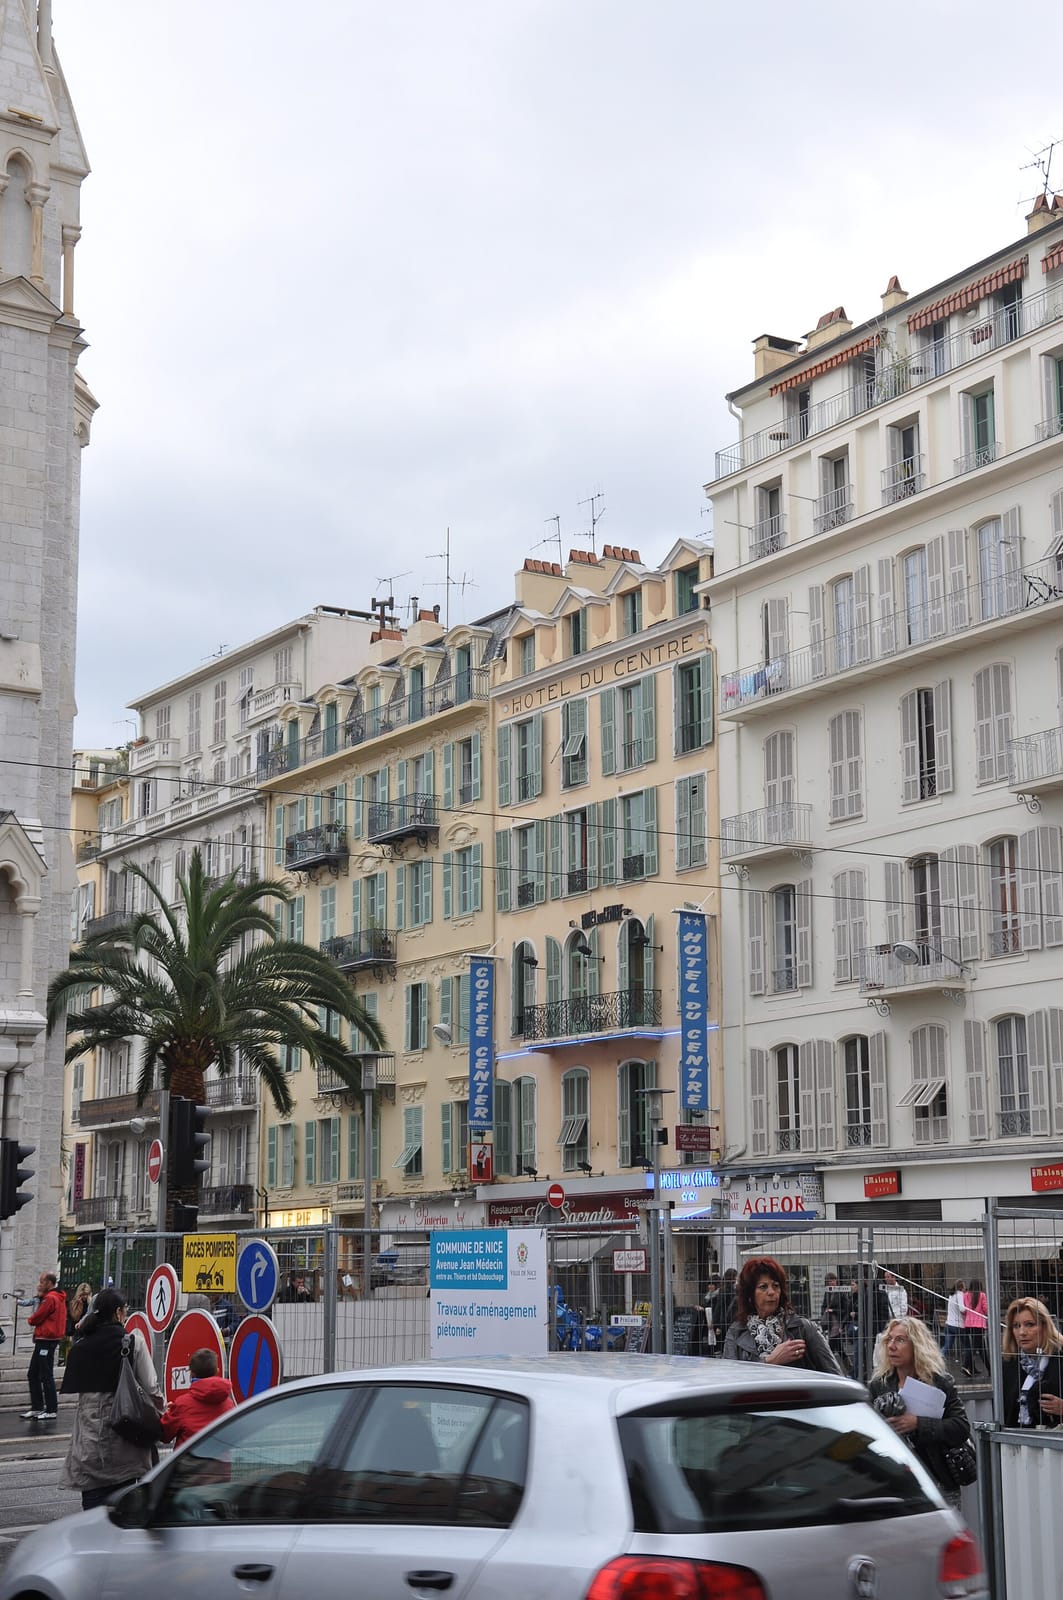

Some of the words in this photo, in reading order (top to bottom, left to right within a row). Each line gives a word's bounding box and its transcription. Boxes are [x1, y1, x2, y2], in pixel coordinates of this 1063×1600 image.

[512, 682, 571, 714] HOTEL
[579, 664, 604, 690] DU
[613, 634, 694, 677] CENTRE
[682, 931, 703, 994] HOTEL
[475, 966, 490, 1038] COFFEE
[685, 1000, 702, 1021] DU
[685, 1028, 703, 1106] CENTRE
[473, 1045, 490, 1120] CENTER
[660, 1172, 681, 1188] HOTEL
[490, 1205, 523, 1215] Restaurant
[205, 1240, 235, 1258] POMPIERS
[436, 1241, 473, 1255] COMMUNE
[473, 1241, 485, 1254] DE
[485, 1240, 504, 1254] NICE
[436, 1259, 459, 1270] Avenue
[459, 1259, 475, 1270] Jean
[475, 1258, 503, 1270] Médecin
[436, 1273, 447, 1281] entre
[453, 1273, 467, 1281] Thiers
[467, 1273, 471, 1281] et
[472, 1273, 478, 1281] bd
[478, 1273, 505, 1282] Dubouchage
[436, 1301, 467, 1316] Travaux
[468, 1301, 537, 1321] d'aménagement
[437, 1321, 477, 1339] piétonnier
